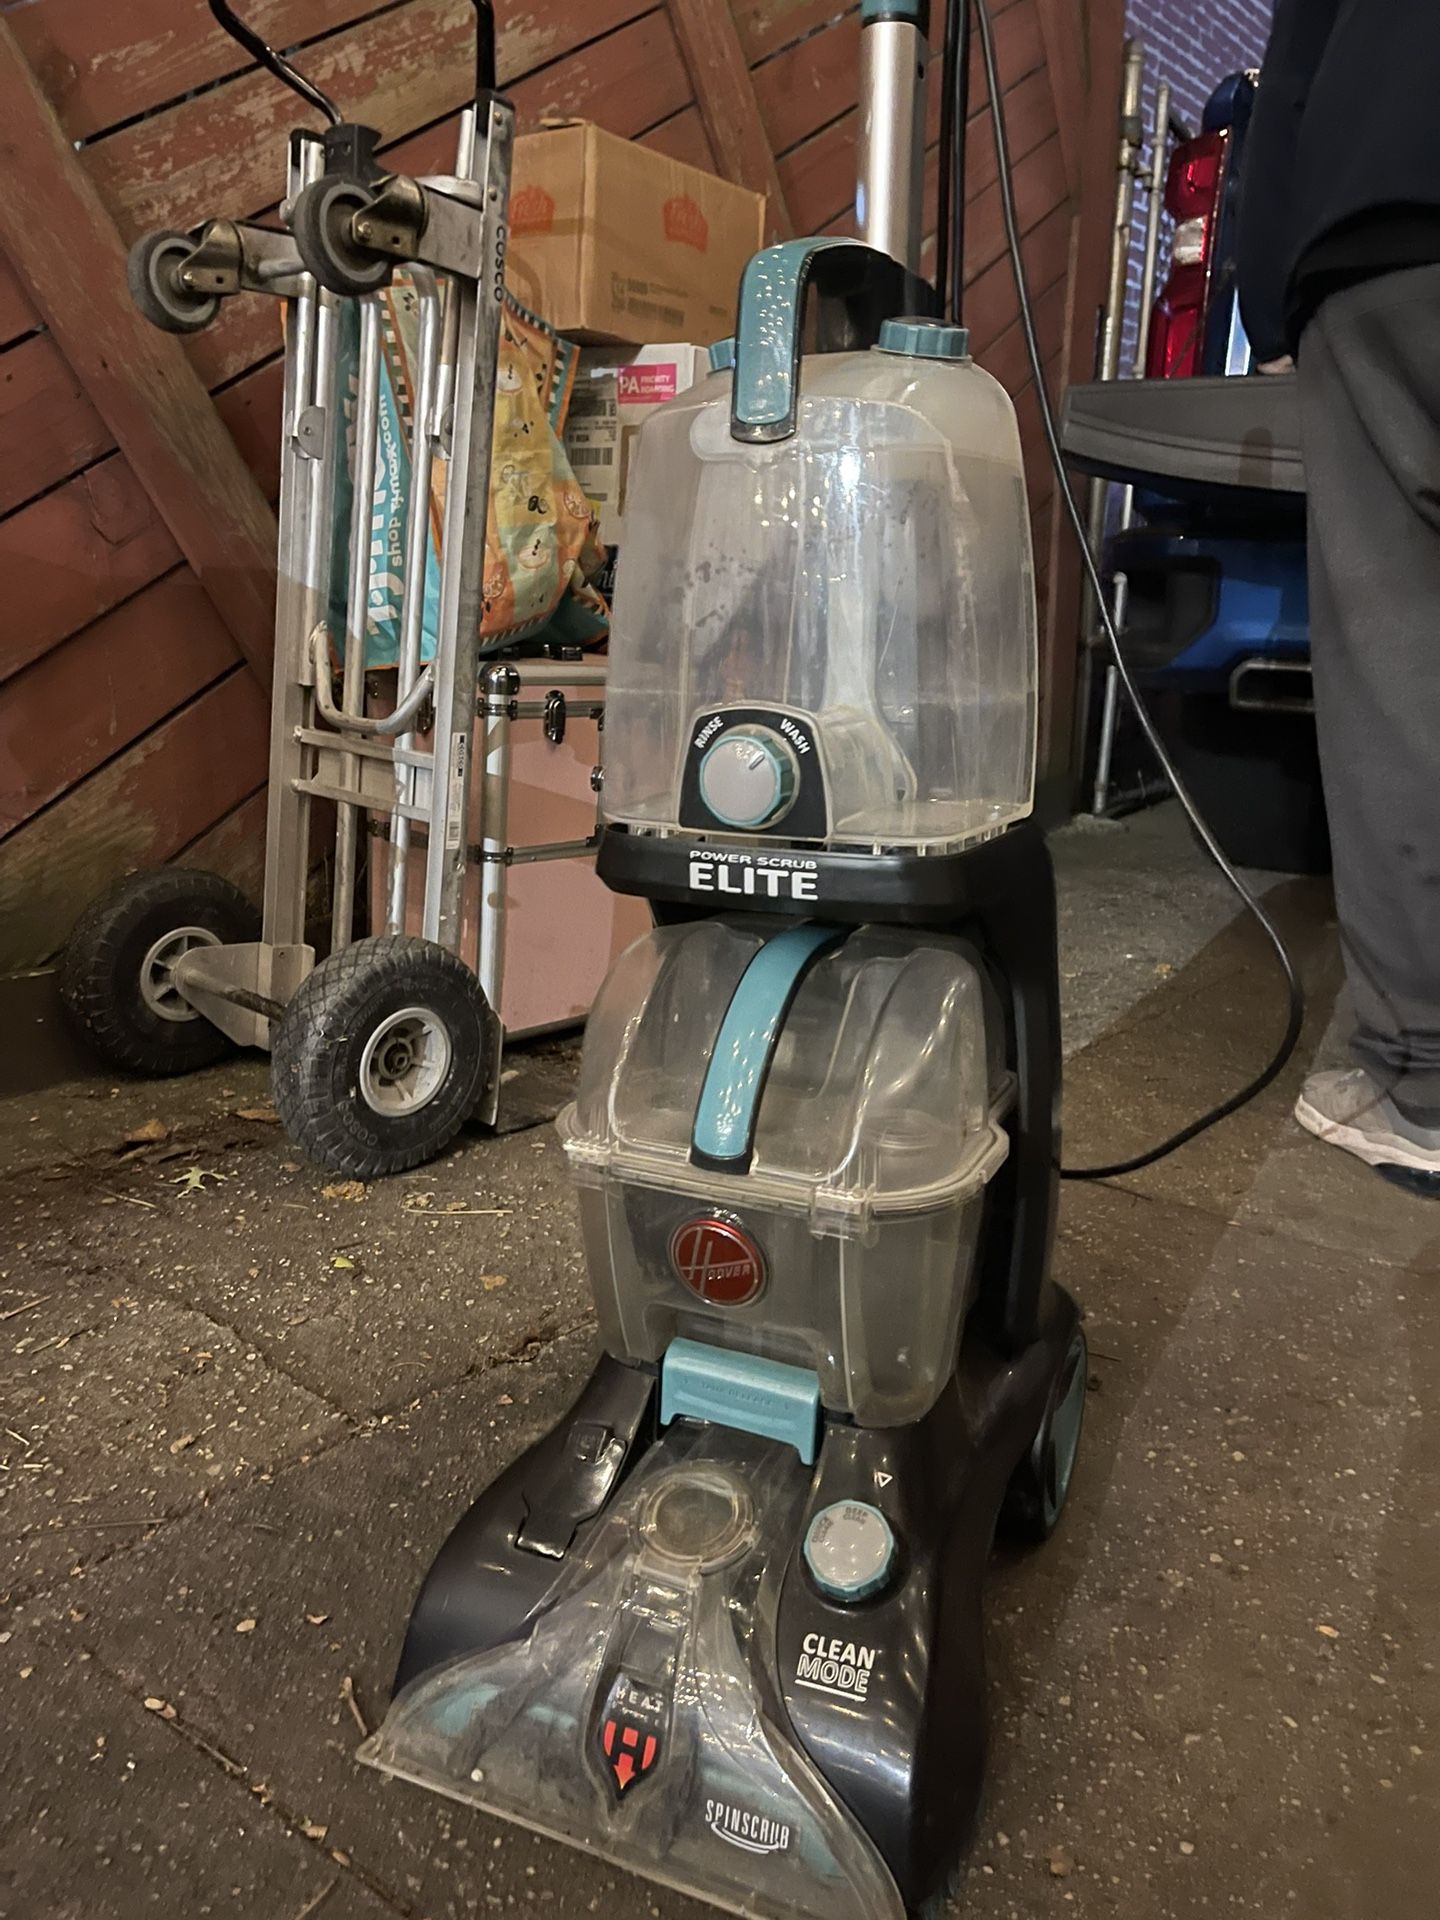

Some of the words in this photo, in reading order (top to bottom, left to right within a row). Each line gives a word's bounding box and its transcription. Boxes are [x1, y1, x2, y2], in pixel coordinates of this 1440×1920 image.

[494, 225, 506, 302] COSCO
[620, 375, 640, 394] PA
[387, 519, 404, 568] shop
[694, 715, 724, 750] RINSE
[779, 718, 811, 755] WASH
[689, 850, 752, 865] POWER
[756, 856, 818, 870] SCRUB
[689, 861, 819, 901] ELITE
[803, 1633, 875, 1670] CLEAN
[796, 1653, 871, 1693] MODE
[616, 1685, 664, 1713] HEAT
[705, 1799, 790, 1850] SPINSCRUB
